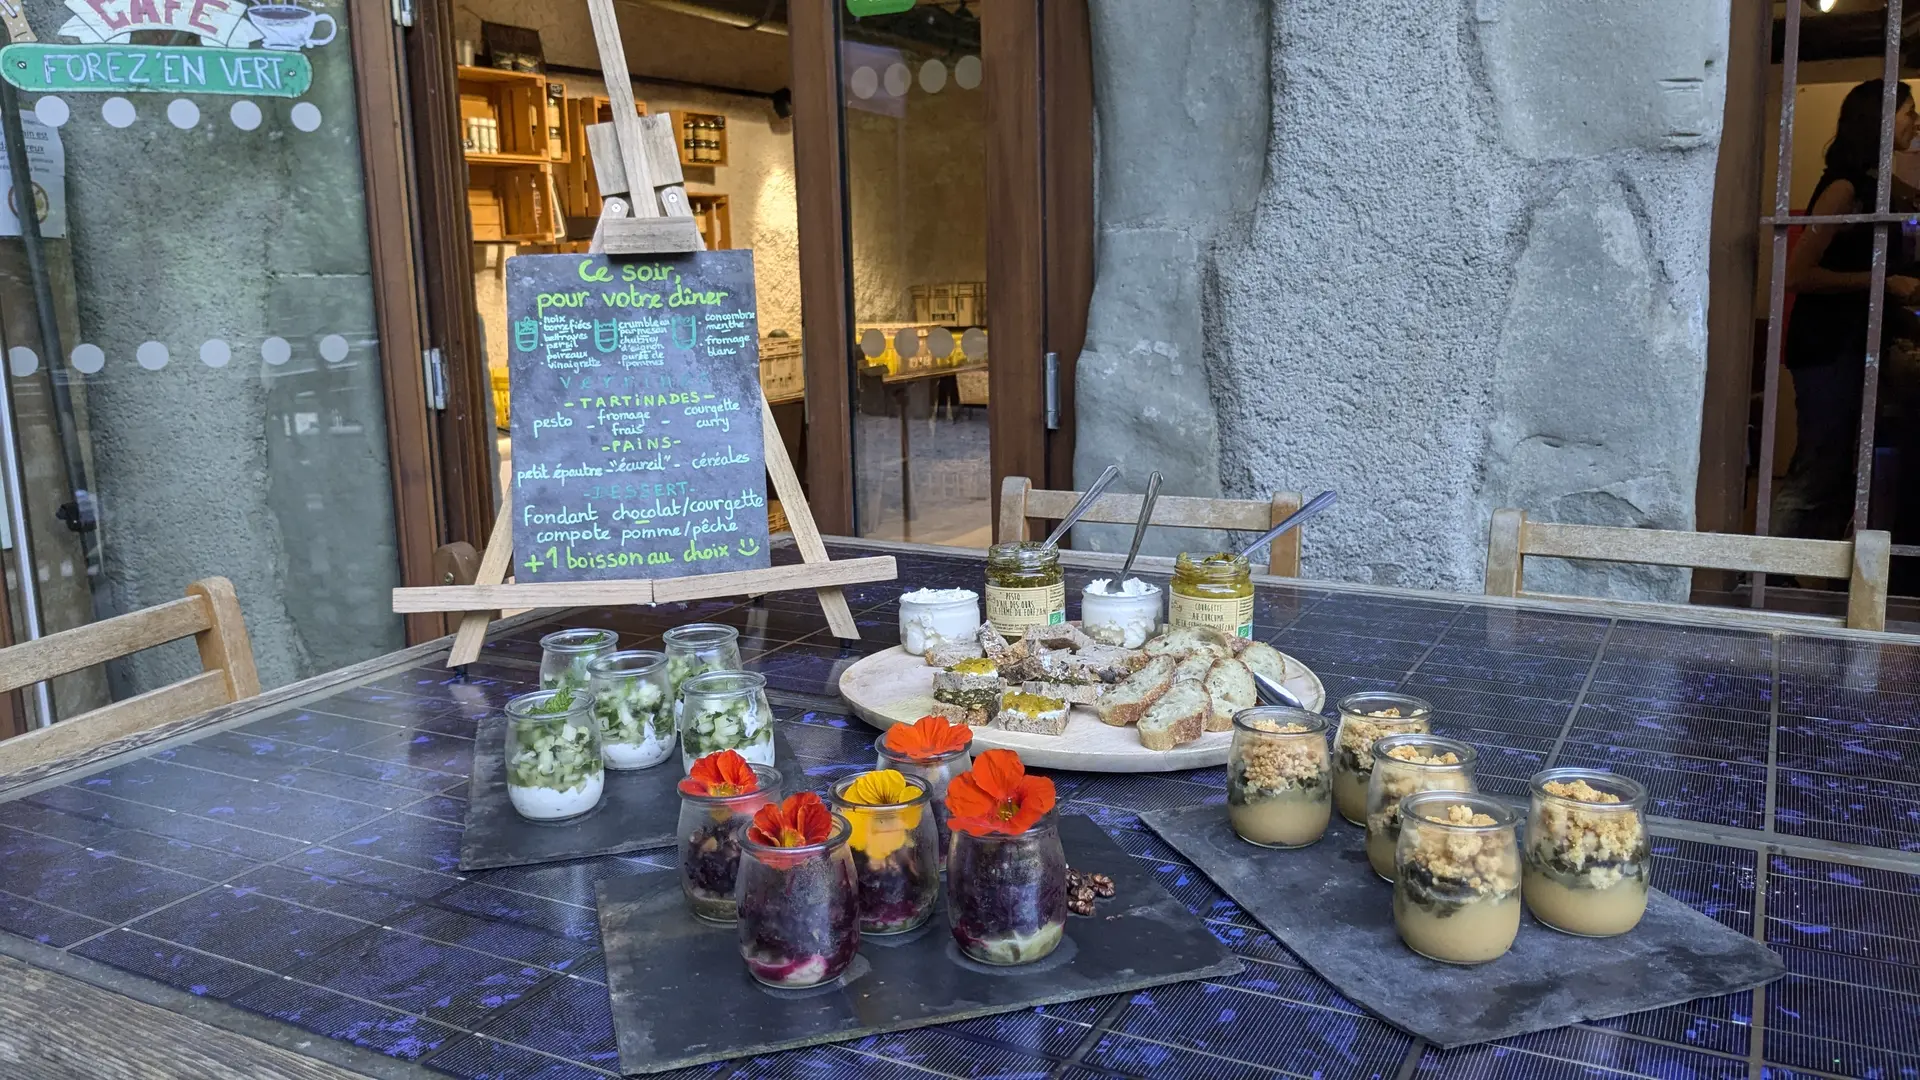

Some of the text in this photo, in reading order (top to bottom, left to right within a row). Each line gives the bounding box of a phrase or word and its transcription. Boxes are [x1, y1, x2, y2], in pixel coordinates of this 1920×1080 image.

[220, 56, 285, 90] VERT
[578, 259, 681, 285] Ce soir,
[536, 283, 729, 319] pour votre dîner
[543, 314, 566, 324] noix
[705, 309, 755, 322] concombre
[618, 316, 660, 329] crumble
[706, 319, 745, 330] menthe
[620, 327, 668, 338] parmesan
[546, 340, 579, 354] persil
[620, 335, 659, 349] chutney
[705, 334, 751, 348] fromage
[546, 351, 588, 364] poireaux
[651, 350, 665, 359] de
[707, 346, 737, 357] blanc
[547, 356, 602, 374] vinaigrette
[625, 359, 665, 371] pommes
[533, 411, 573, 439] pesto
[597, 408, 651, 425] fromage
[684, 396, 741, 419] courgette
[611, 414, 730, 437] frais curry
[517, 463, 550, 488] petit
[552, 463, 603, 487] épautre
[692, 445, 751, 469] céréales
[537, 522, 612, 548] compote
[566, 546, 644, 570] boisson
[647, 551, 675, 565] au
[683, 540, 730, 562] choix
[1005, 592, 1021, 600] PESTO
[1010, 601, 1020, 609] DES
[1021, 601, 1035, 609] OURS
[1194, 603, 1222, 612] COURGETTE
[1201, 614, 1224, 622] CURCUMA
